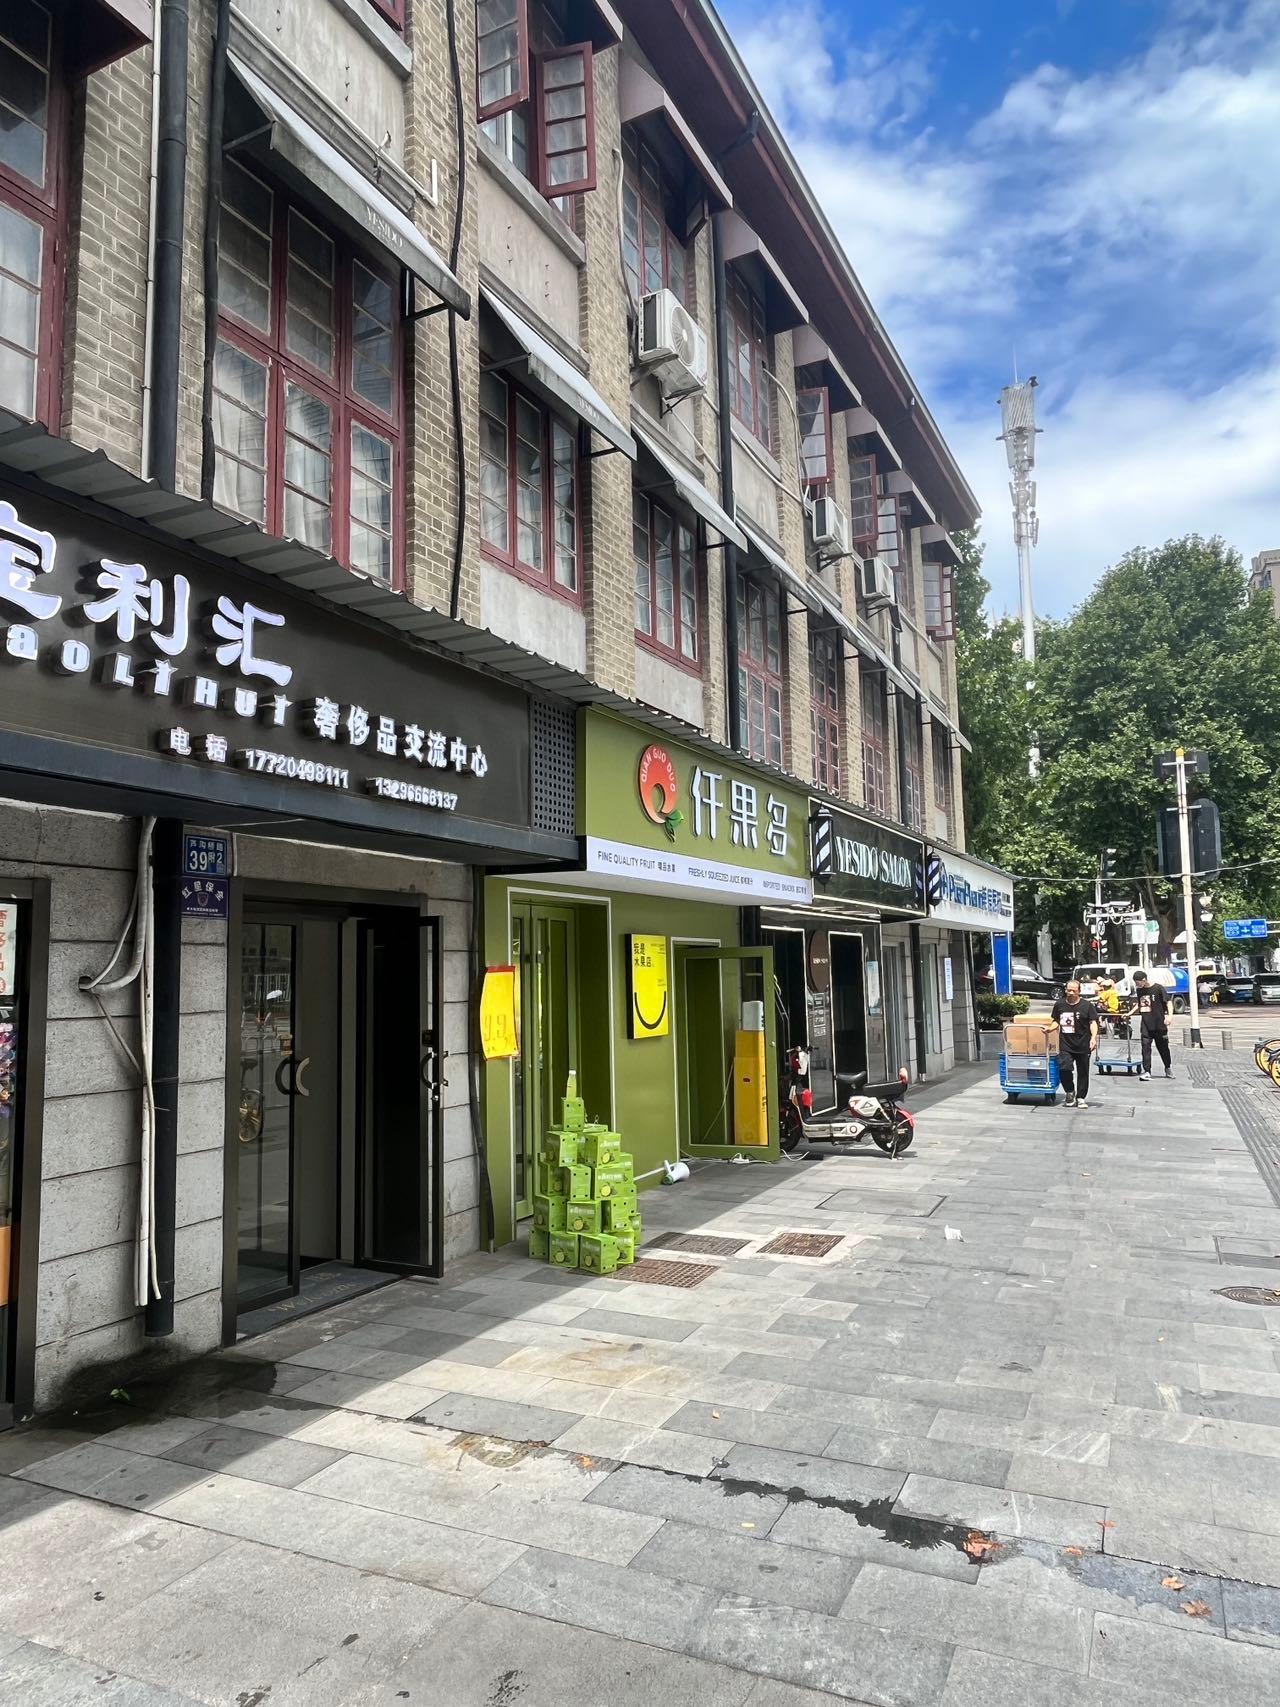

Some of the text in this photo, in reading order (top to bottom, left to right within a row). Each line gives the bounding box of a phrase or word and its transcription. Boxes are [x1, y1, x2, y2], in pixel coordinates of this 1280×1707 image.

[170, 726, 228, 763] 电话
[245, 748, 349, 789] 17720498111
[313, 696, 488, 778] 奢侈品交流中心
[189, 850, 208, 871] 39
[597, 850, 613, 862] FINE
[613, 854, 639, 867] QUALITY
[639, 858, 656, 869] FRUIT
[835, 836, 879, 881] YESIDO
[881, 850, 912, 888] SALON
